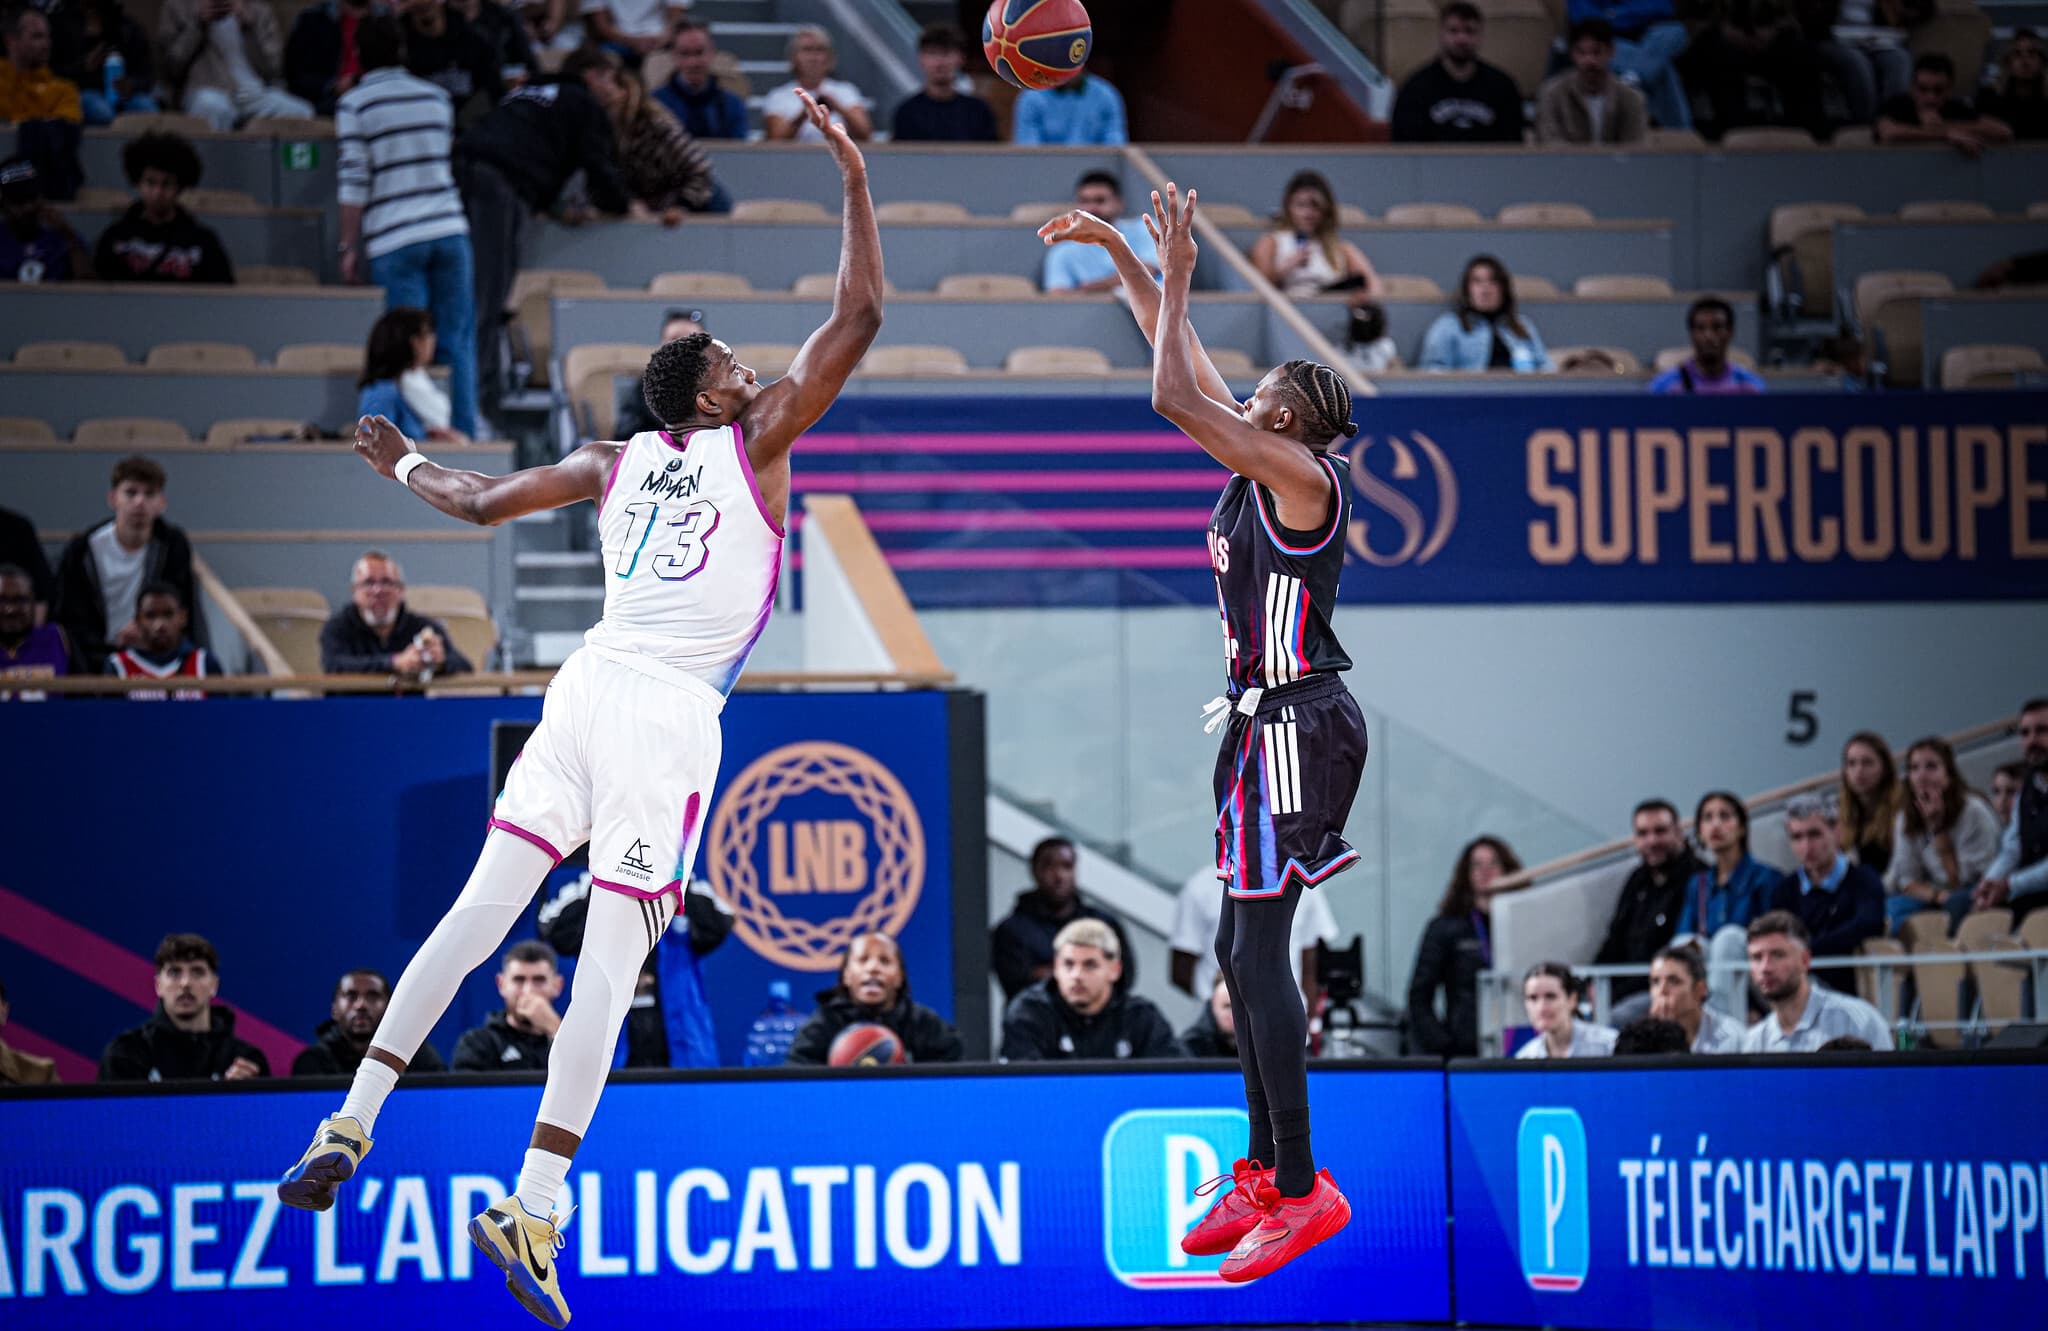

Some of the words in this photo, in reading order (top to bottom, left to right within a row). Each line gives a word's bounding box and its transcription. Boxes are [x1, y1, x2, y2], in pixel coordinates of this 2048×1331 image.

[639, 465, 704, 501] MIYEN
[1528, 427, 2048, 564] SUPERCOUPE
[615, 499, 721, 582] 13
[1786, 691, 1819, 746] 5
[615, 866, 651, 882] Jaroussie
[768, 819, 868, 895] LNB
[0, 1181, 290, 1295] RGEZ
[1619, 1133, 1917, 1275] TÉLÉCHARGEZ
[1923, 1161, 2048, 1280] L'APP
